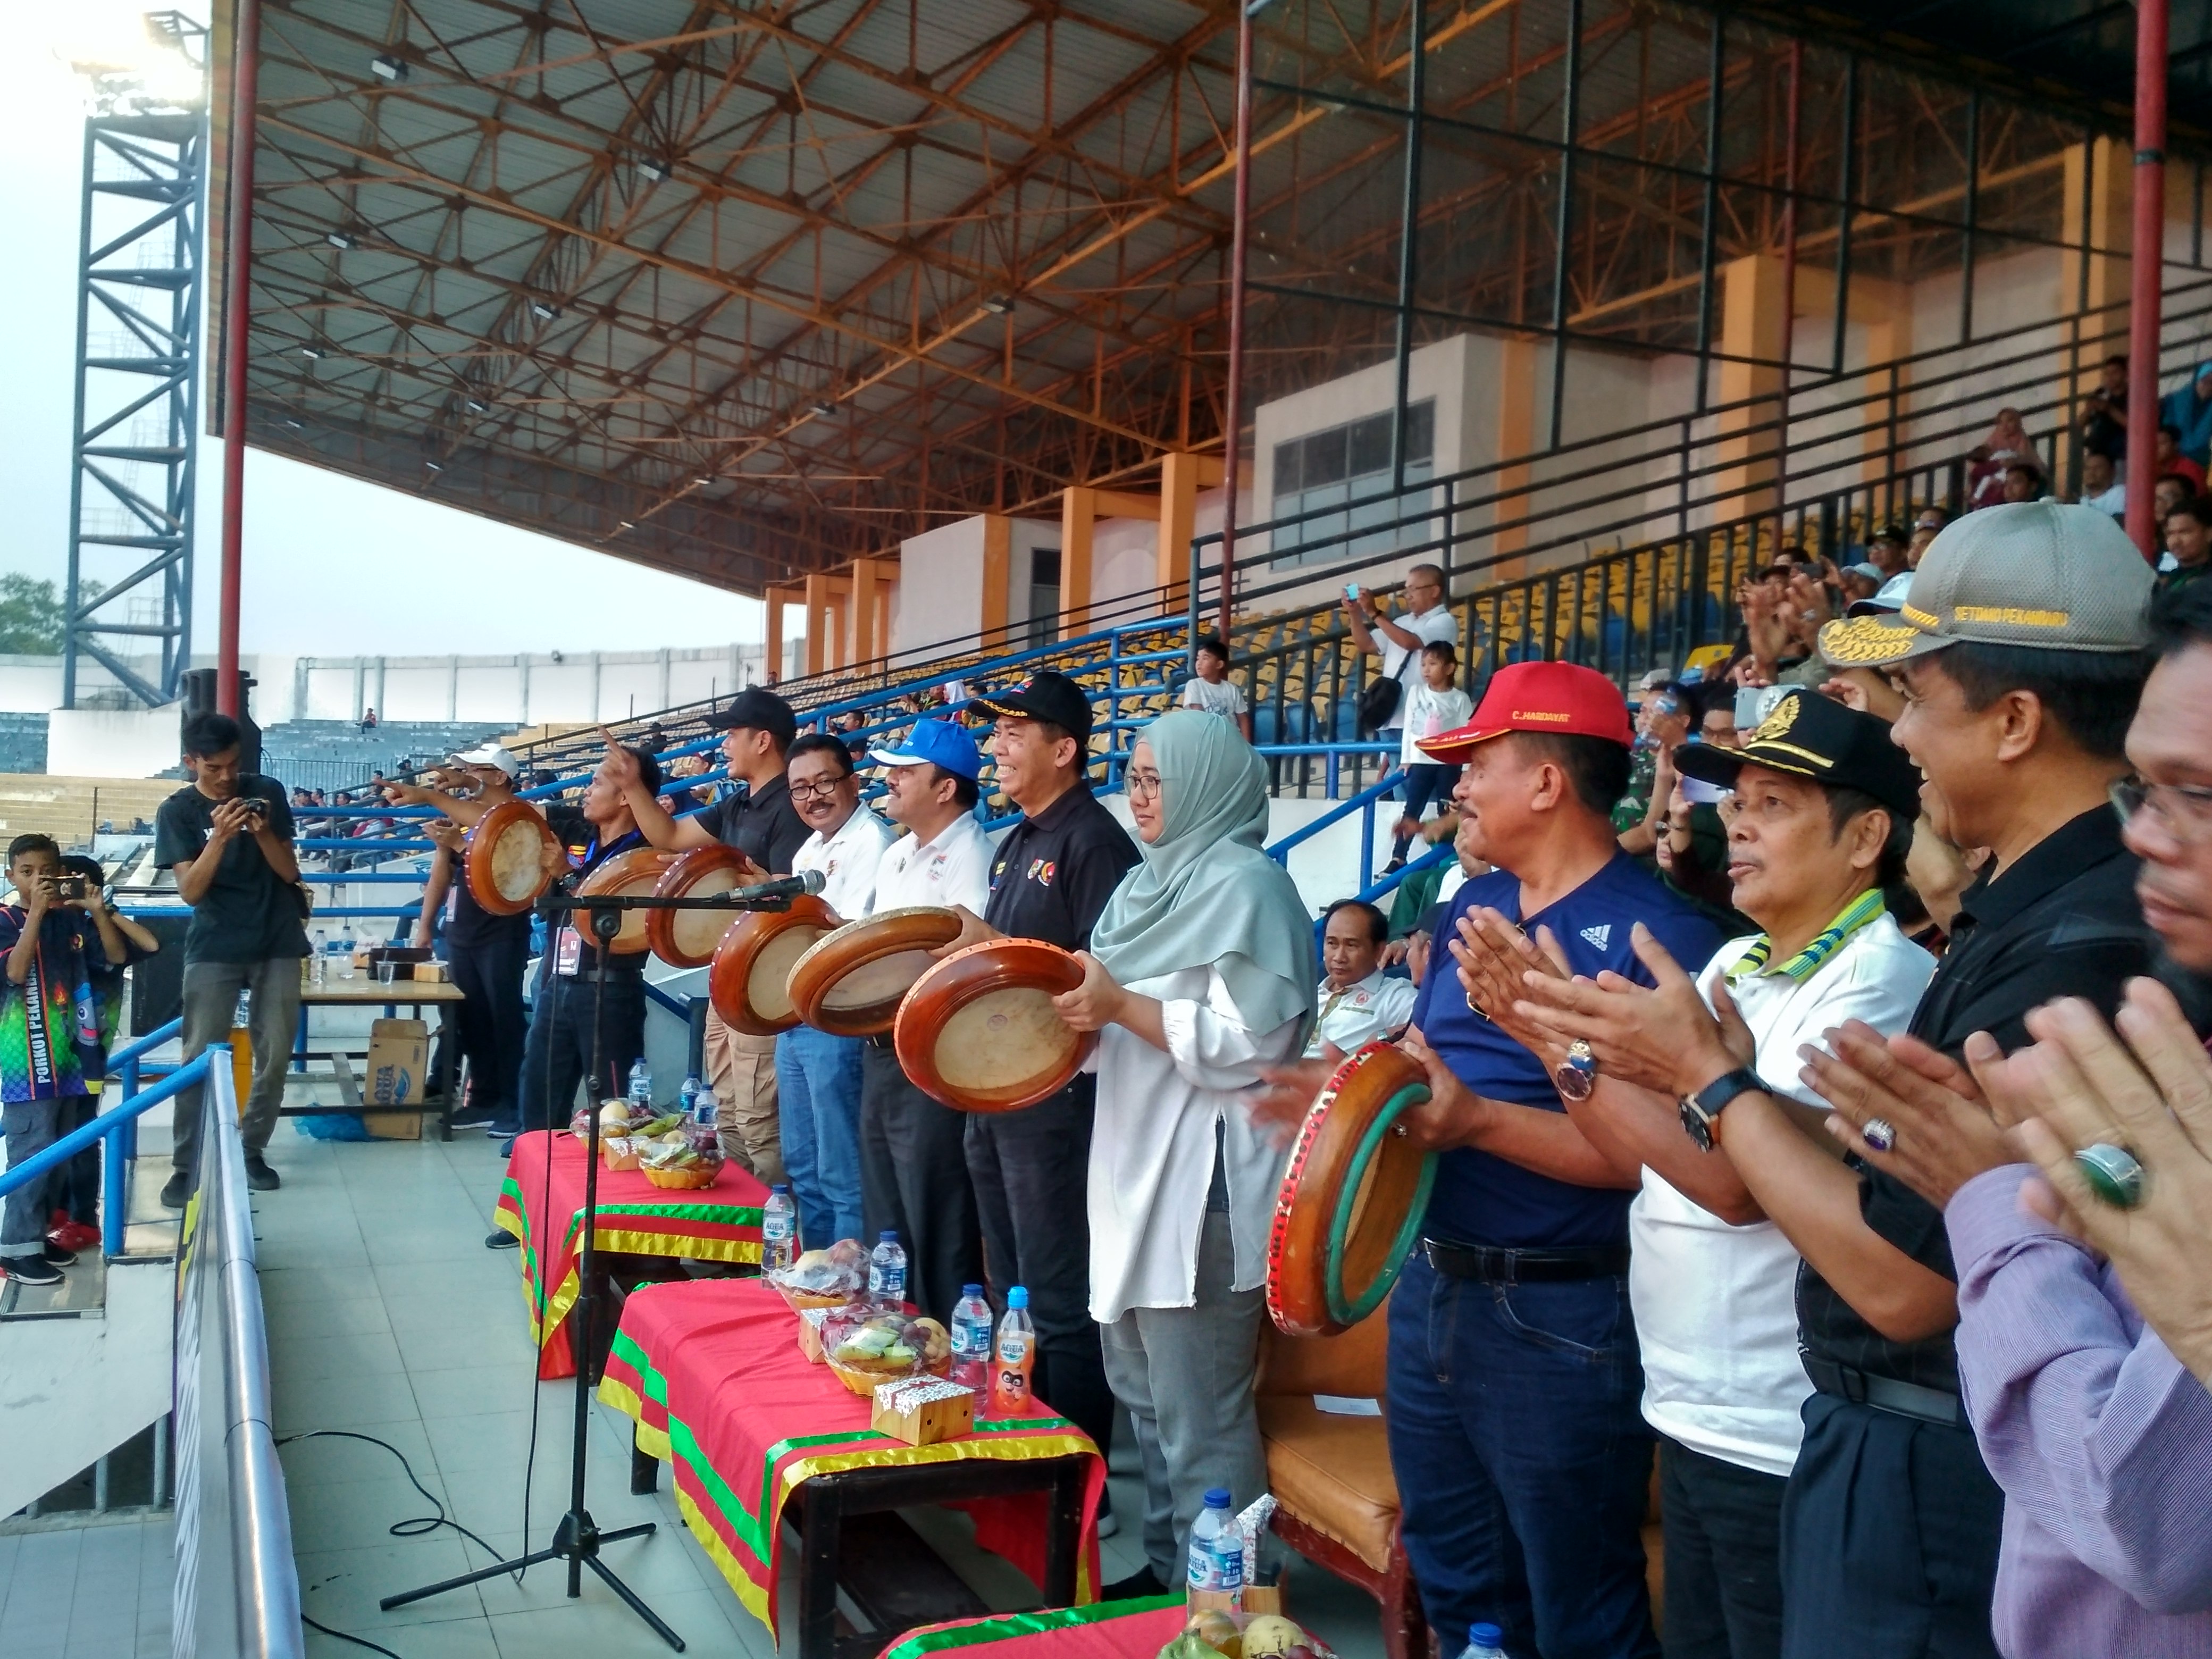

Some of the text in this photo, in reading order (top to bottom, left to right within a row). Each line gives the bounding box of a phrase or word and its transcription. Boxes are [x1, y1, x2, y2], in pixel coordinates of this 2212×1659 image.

[1580, 929, 1608, 951] adidas
[30, 1033, 51, 1084] PORKOT
[374, 1064, 396, 1105] QUA
[766, 1222, 784, 1230] AQUA
[1001, 1343, 1024, 1353] AQUA
[1189, 1554, 1208, 1572] QUA
